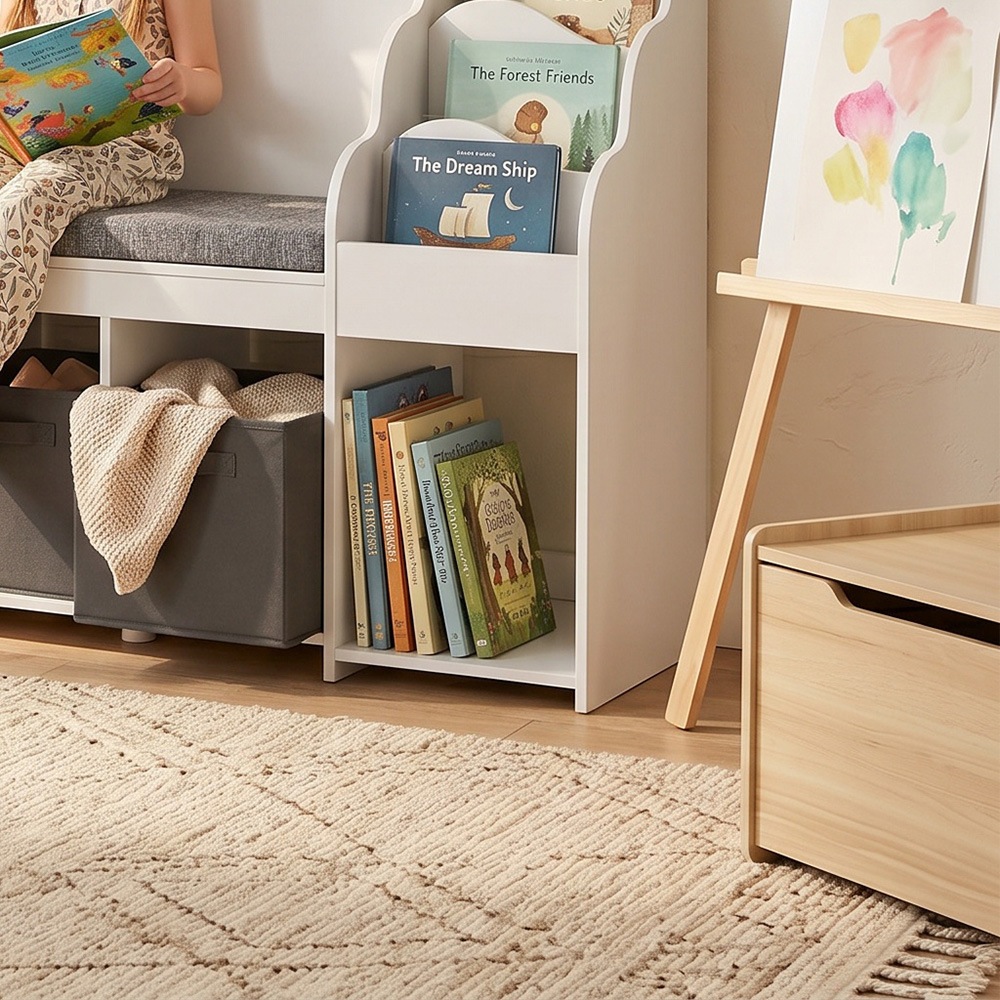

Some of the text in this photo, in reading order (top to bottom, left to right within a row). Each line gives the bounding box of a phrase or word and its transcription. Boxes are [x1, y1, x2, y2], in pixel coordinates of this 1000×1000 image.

[470, 66, 595, 85] The Forest Friends
[412, 156, 538, 183] The Dream Ship
